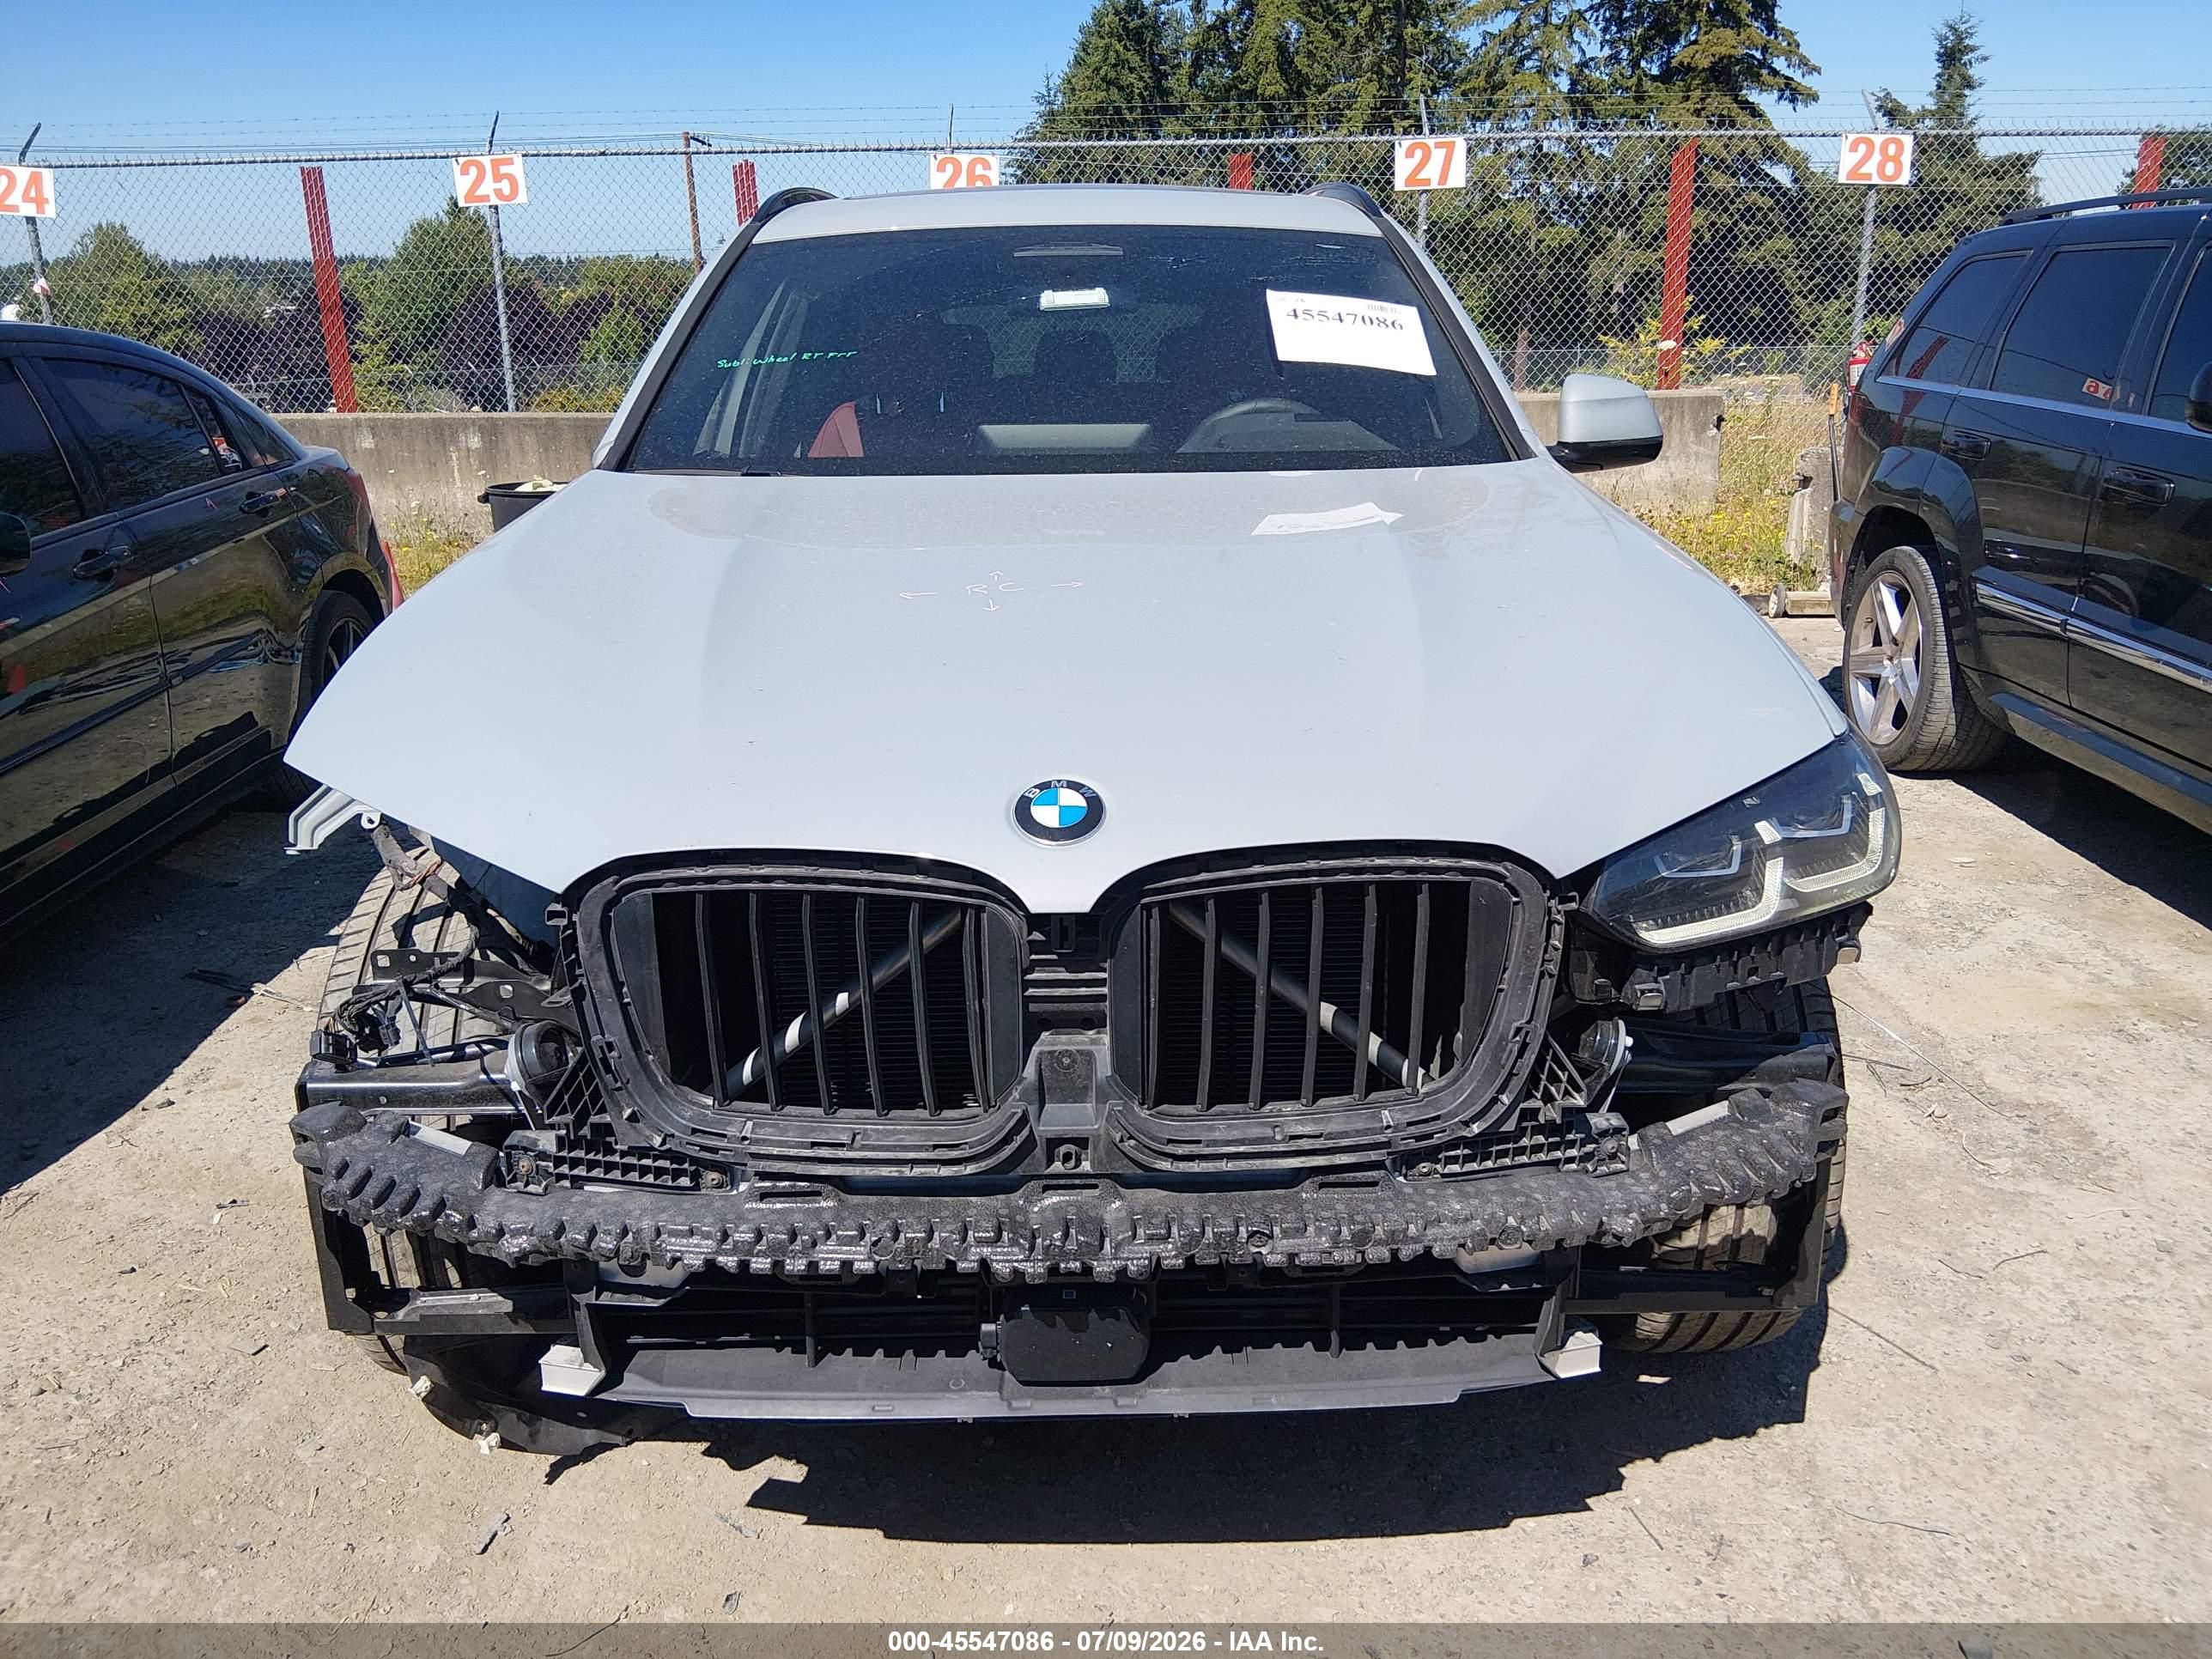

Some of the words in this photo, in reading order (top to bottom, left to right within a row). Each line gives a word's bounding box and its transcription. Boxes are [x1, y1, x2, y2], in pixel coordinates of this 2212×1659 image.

[459, 157, 520, 204] 25
[937, 156, 993, 188] 26
[1405, 141, 1456, 187] 27
[1846, 137, 1905, 182] 28
[0, 168, 50, 215] 24
[1286, 307, 1404, 331] 45547086
[1024, 780, 1097, 799] BMW
